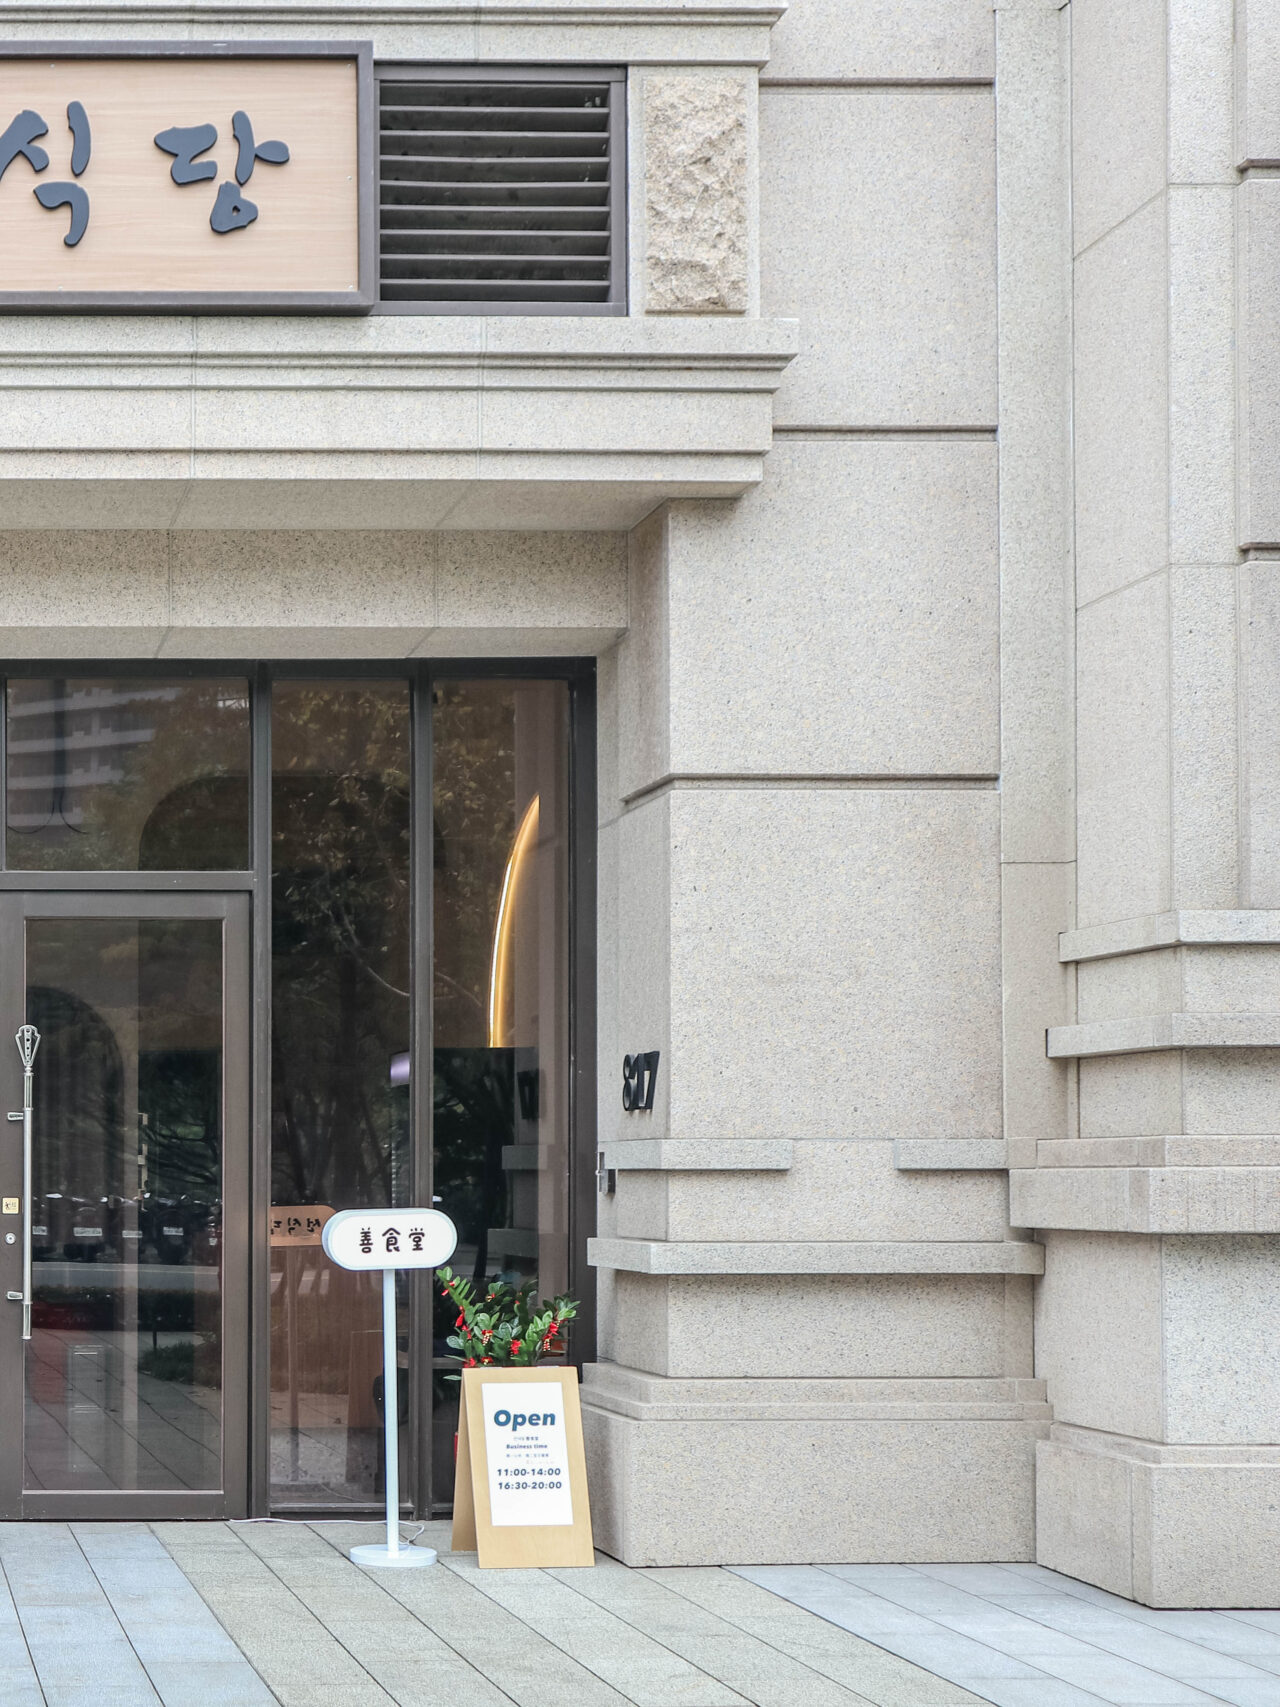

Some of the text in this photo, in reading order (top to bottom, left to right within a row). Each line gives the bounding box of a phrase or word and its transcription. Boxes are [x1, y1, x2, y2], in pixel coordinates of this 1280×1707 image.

[359, 1227, 425, 1254] 善食堂
[493, 1409, 556, 1432] Open
[497, 1468, 561, 1477] 11:00-14:00
[498, 1481, 562, 1490] 16:30-20:00
